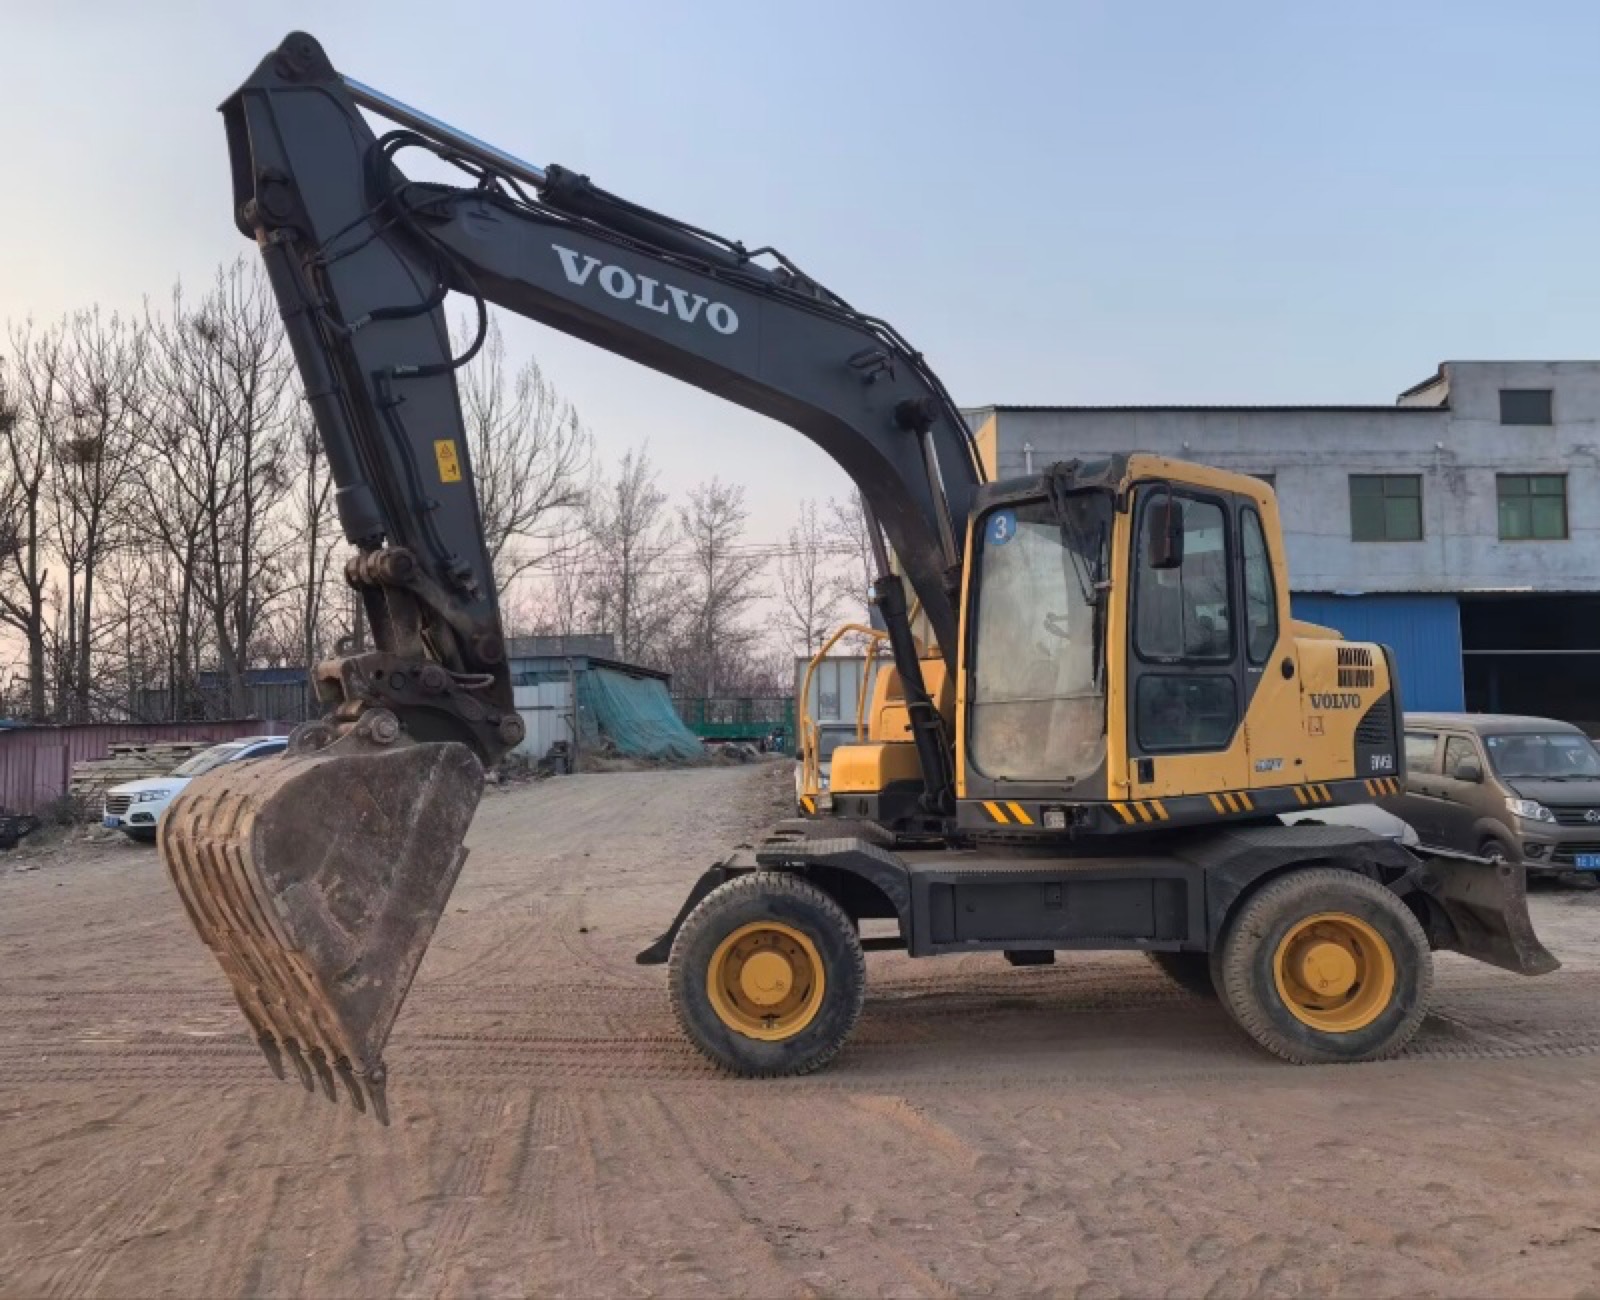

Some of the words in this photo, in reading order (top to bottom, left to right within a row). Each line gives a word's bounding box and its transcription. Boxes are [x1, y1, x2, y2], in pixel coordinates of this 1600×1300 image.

[552, 244, 739, 335] VOLVO
[995, 515, 1007, 539] 3
[1309, 693, 1361, 709] VOLVO
